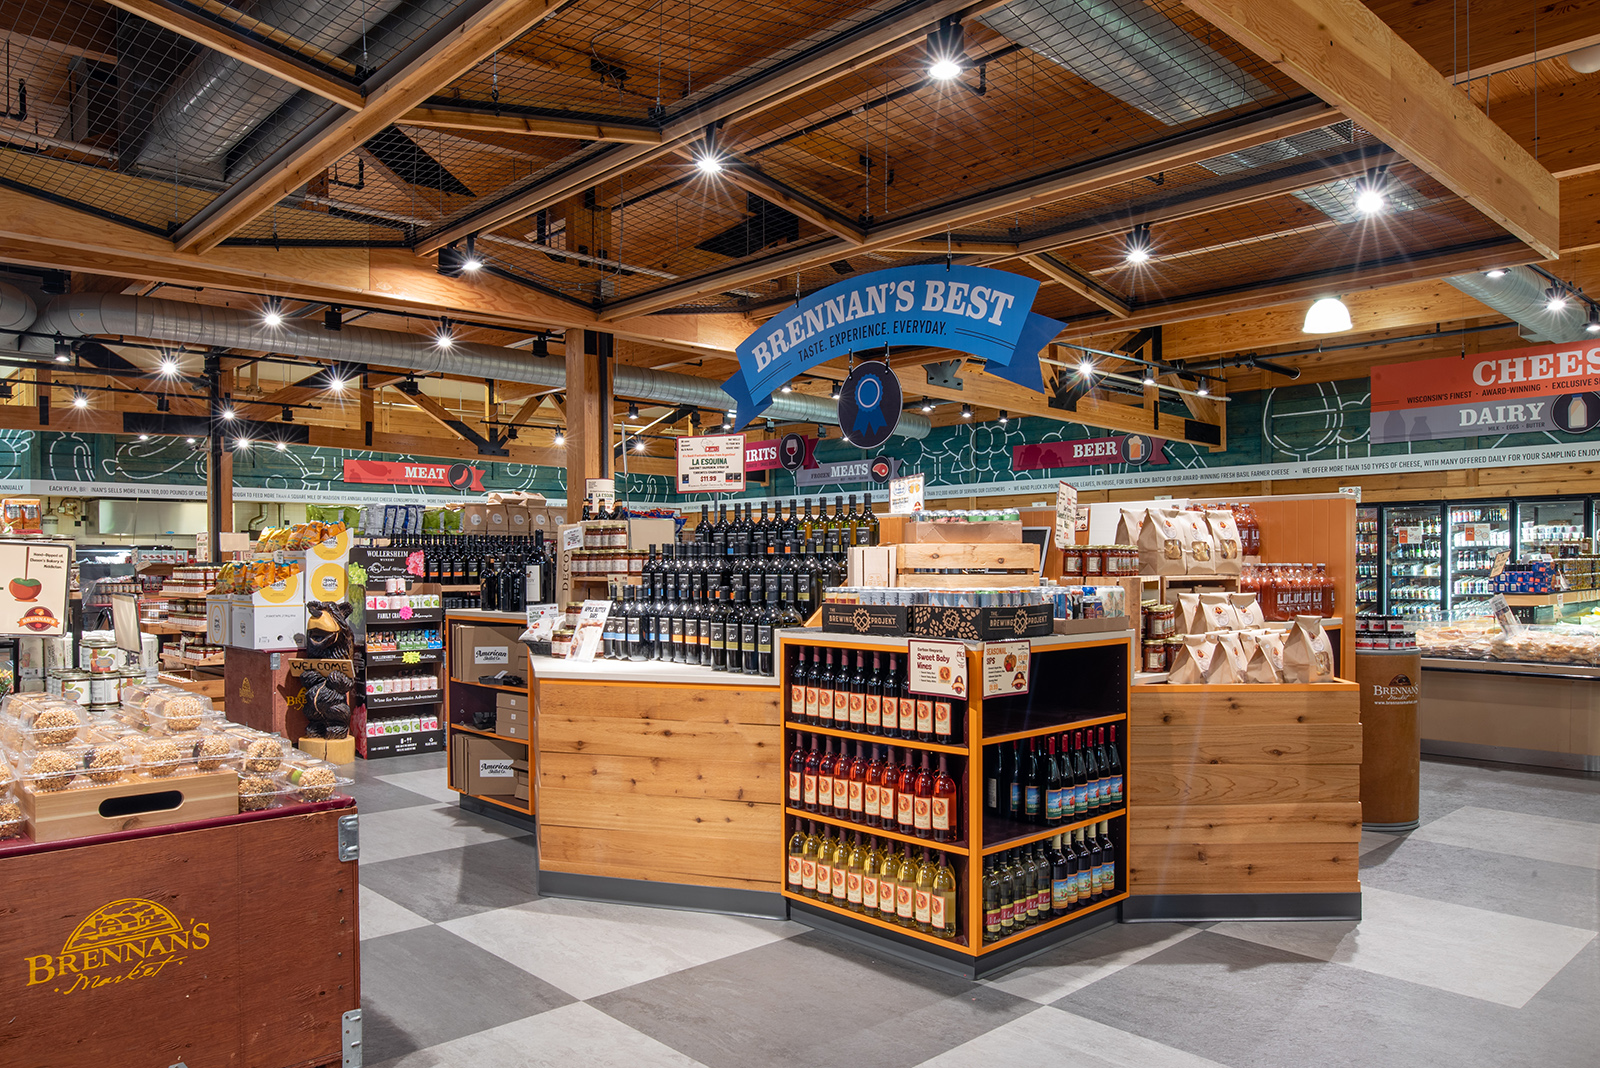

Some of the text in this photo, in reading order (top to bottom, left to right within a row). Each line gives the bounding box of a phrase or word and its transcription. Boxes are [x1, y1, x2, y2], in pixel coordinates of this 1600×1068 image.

[751, 280, 1015, 374] BRENNAN'S BEST
[798, 320, 947, 362] TASTE. EXPERIENCE. EVERYDAY.
[1472, 348, 1600, 386] CHEES
[1407, 393, 1448, 404] WISCONSIN'S
[1450, 390, 1472, 400] FINEST
[1482, 384, 1541, 397] AWARD-WINNING
[1552, 378, 1592, 389] EXCLUSIVE
[1459, 402, 1545, 426] DAIRY
[746, 447, 777, 463] IRITS
[1073, 442, 1118, 458] BEER
[1399, 460, 1422, 468] CHEESE,
[1541, 450, 1576, 459] SAMPLING
[405, 466, 445, 479] MEAT
[830, 463, 869, 478] MEATS
[1182, 472, 1220, 481] AWARD-WINNING
[1028, 616, 1047, 624] PROJEKT
[476, 649, 507, 658] American
[917, 653, 935, 661] Sweet
[936, 654, 950, 663] Baby
[986, 647, 1007, 655] SEASONAL
[291, 662, 348, 671] WELCOME
[917, 662, 932, 670] Vines
[1373, 682, 1419, 696] BRENNAN'S
[481, 762, 512, 771] American
[24, 918, 210, 987] BRENNAN'S
[63, 954, 188, 995] Market
